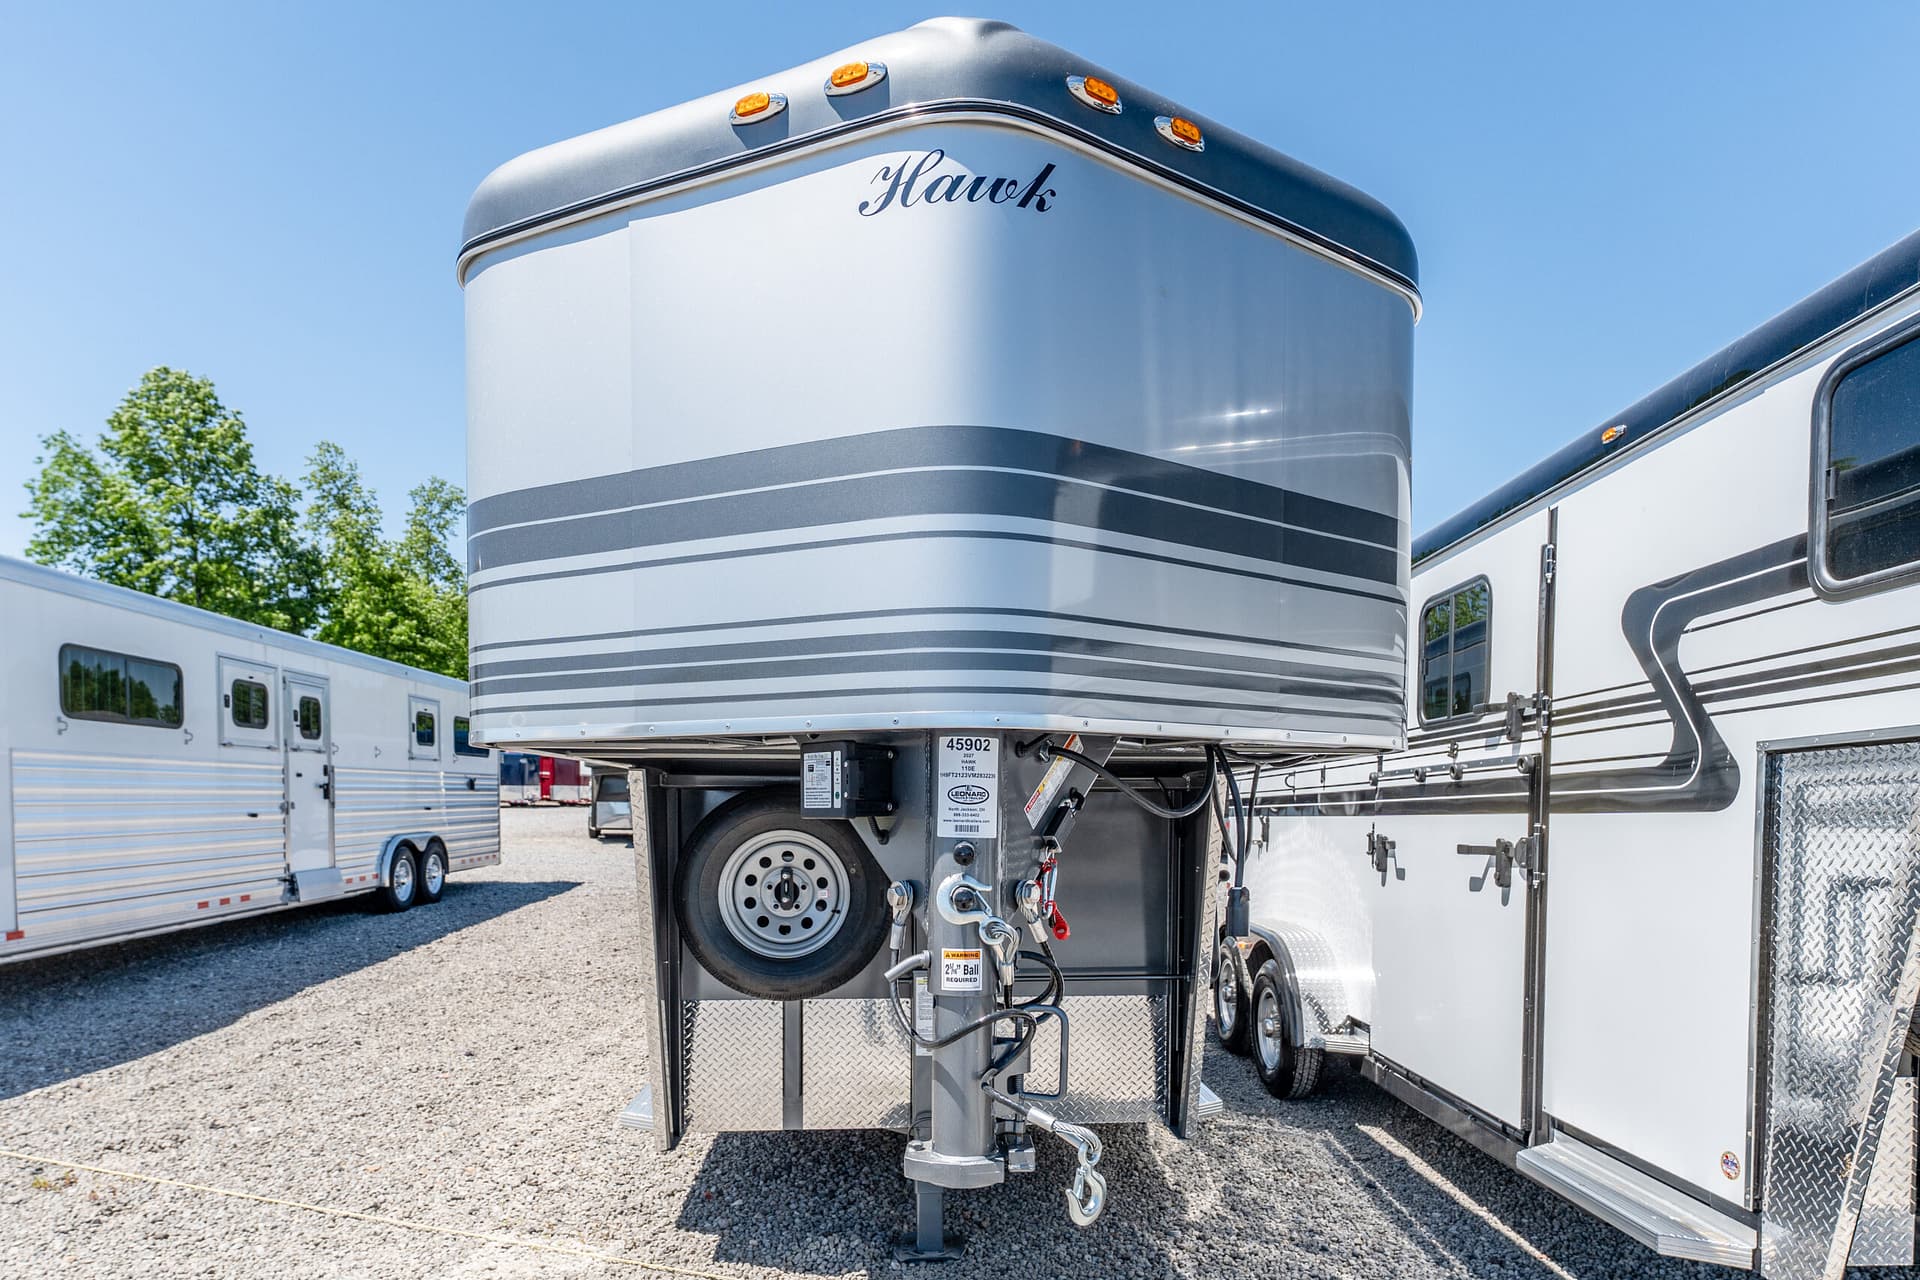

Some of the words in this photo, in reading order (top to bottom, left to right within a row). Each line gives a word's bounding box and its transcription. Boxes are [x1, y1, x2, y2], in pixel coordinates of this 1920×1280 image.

[858, 148, 1057, 216] Hawk
[946, 738, 990, 751] 45902
[963, 963, 979, 975] Ball
